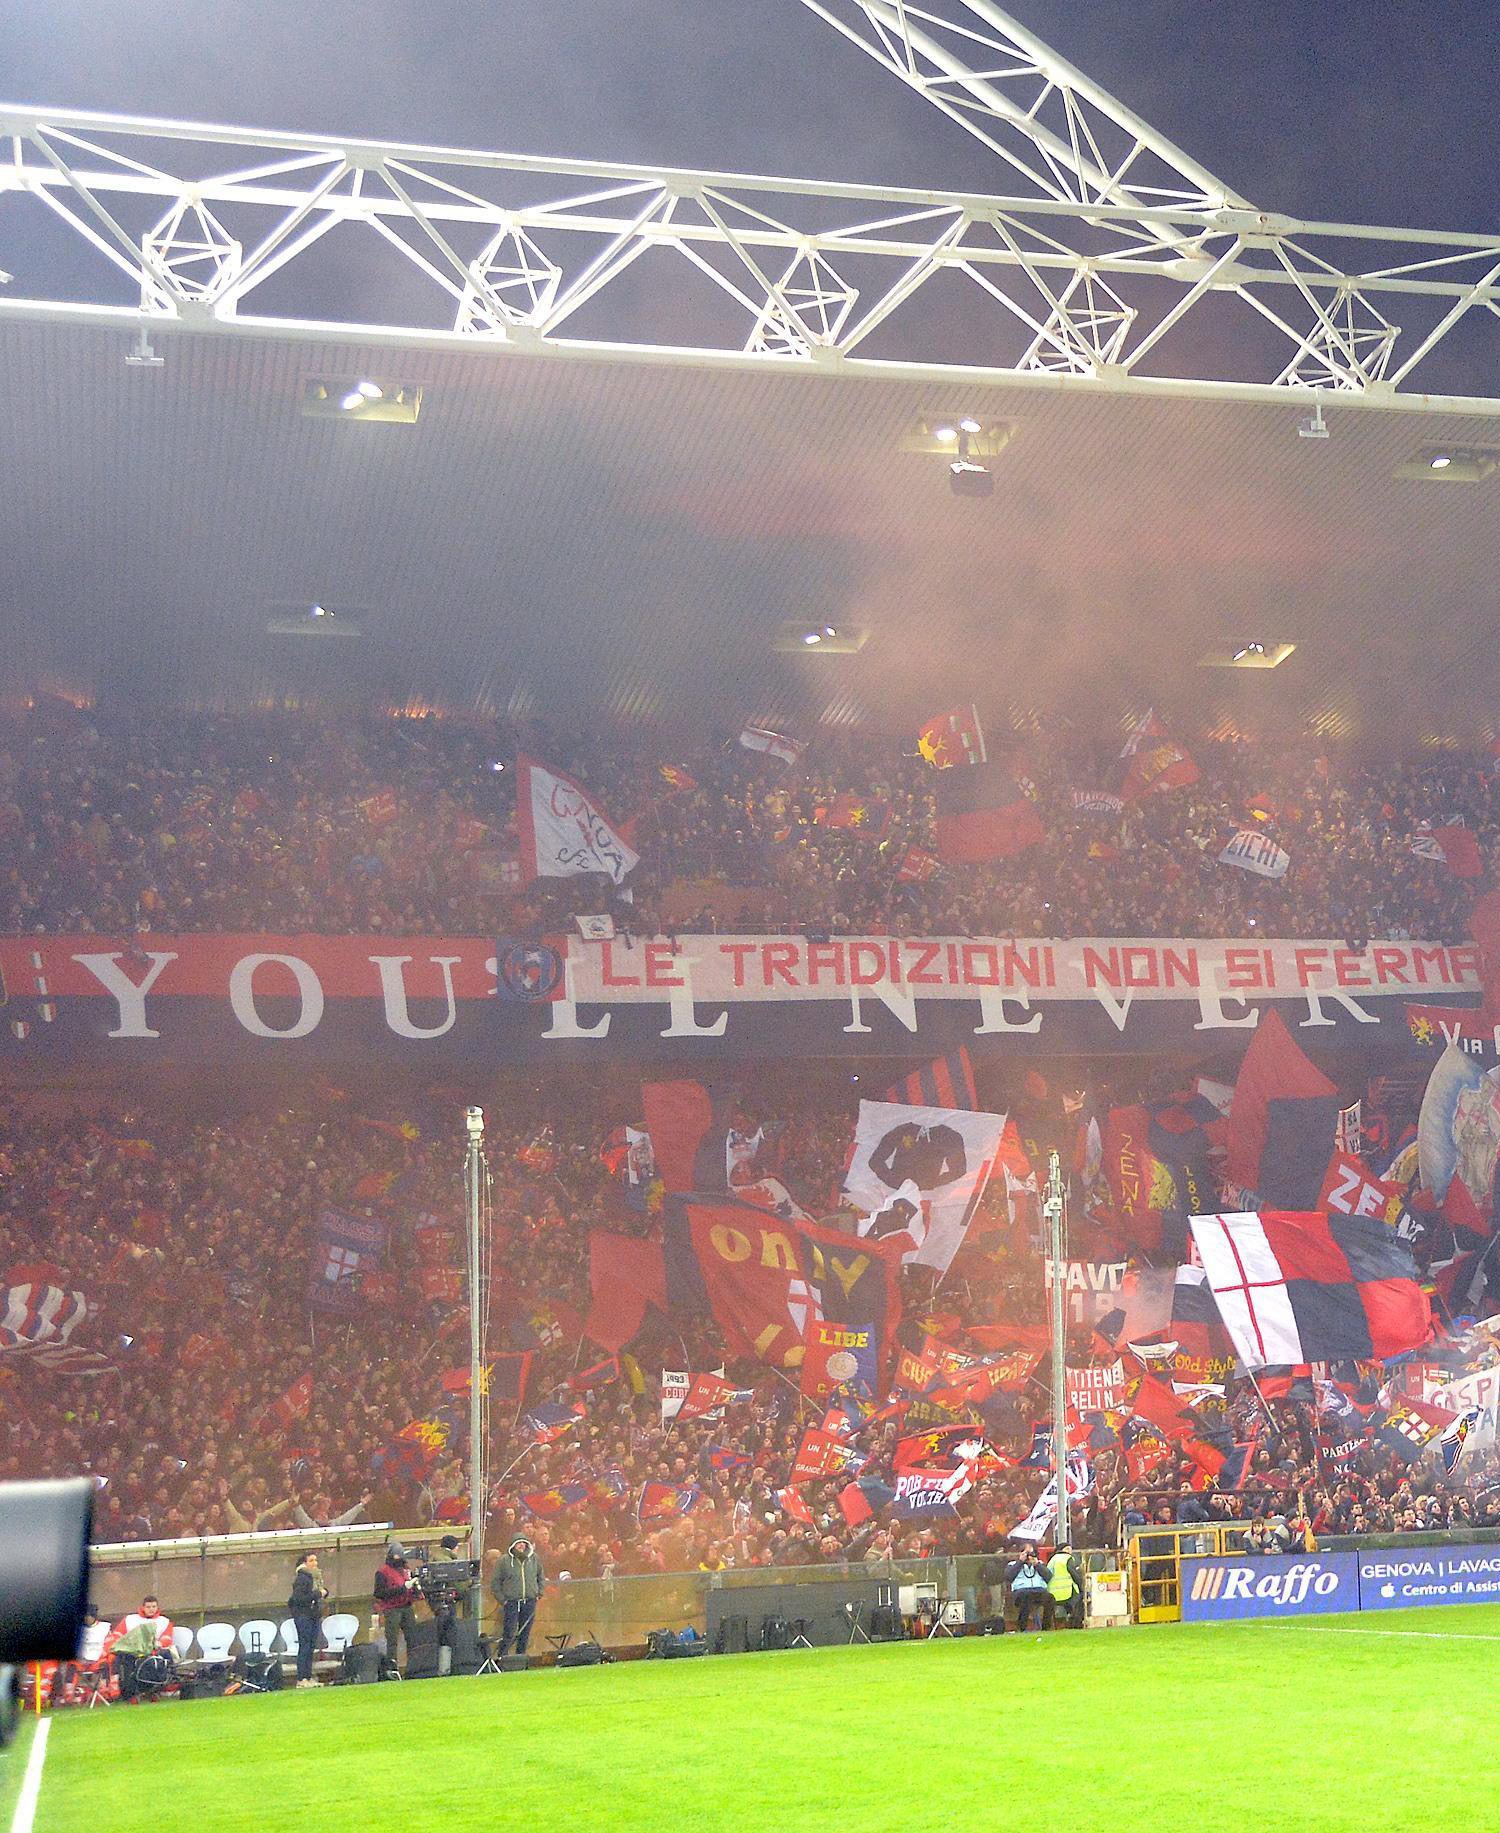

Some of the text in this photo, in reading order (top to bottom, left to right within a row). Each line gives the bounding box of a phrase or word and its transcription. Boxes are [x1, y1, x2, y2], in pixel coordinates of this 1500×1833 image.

[602, 942, 684, 986] LE
[720, 941, 1056, 987] TRADIZIONI
[1083, 946, 1200, 988] NON
[1225, 948, 1277, 988] SI
[1222, 1563, 1339, 1605] Raffo
[1361, 1561, 1435, 1579] GENOVA
[1402, 1583, 1447, 1597] Centro
[1450, 1581, 1463, 1594] di
